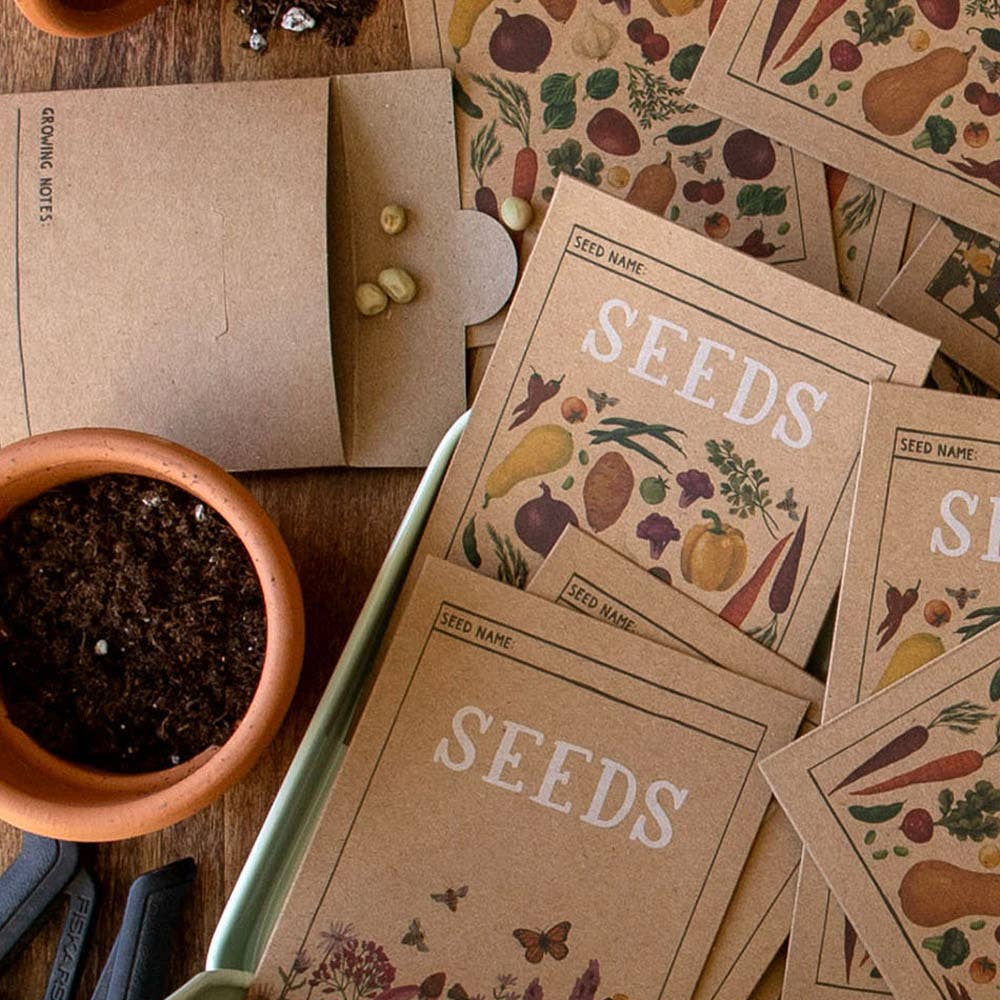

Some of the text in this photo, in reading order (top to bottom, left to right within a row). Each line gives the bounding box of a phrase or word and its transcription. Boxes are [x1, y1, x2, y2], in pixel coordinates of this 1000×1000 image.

[40, 107, 54, 225] GROWING NOTES:
[575, 237, 646, 275] SEED NAME:
[580, 298, 828, 449] SEEDS
[900, 438, 978, 461] SEED NAME:
[568, 583, 599, 608] SEED
[440, 612, 514, 649] SEED NAME:
[434, 705, 688, 849] SEEDS
